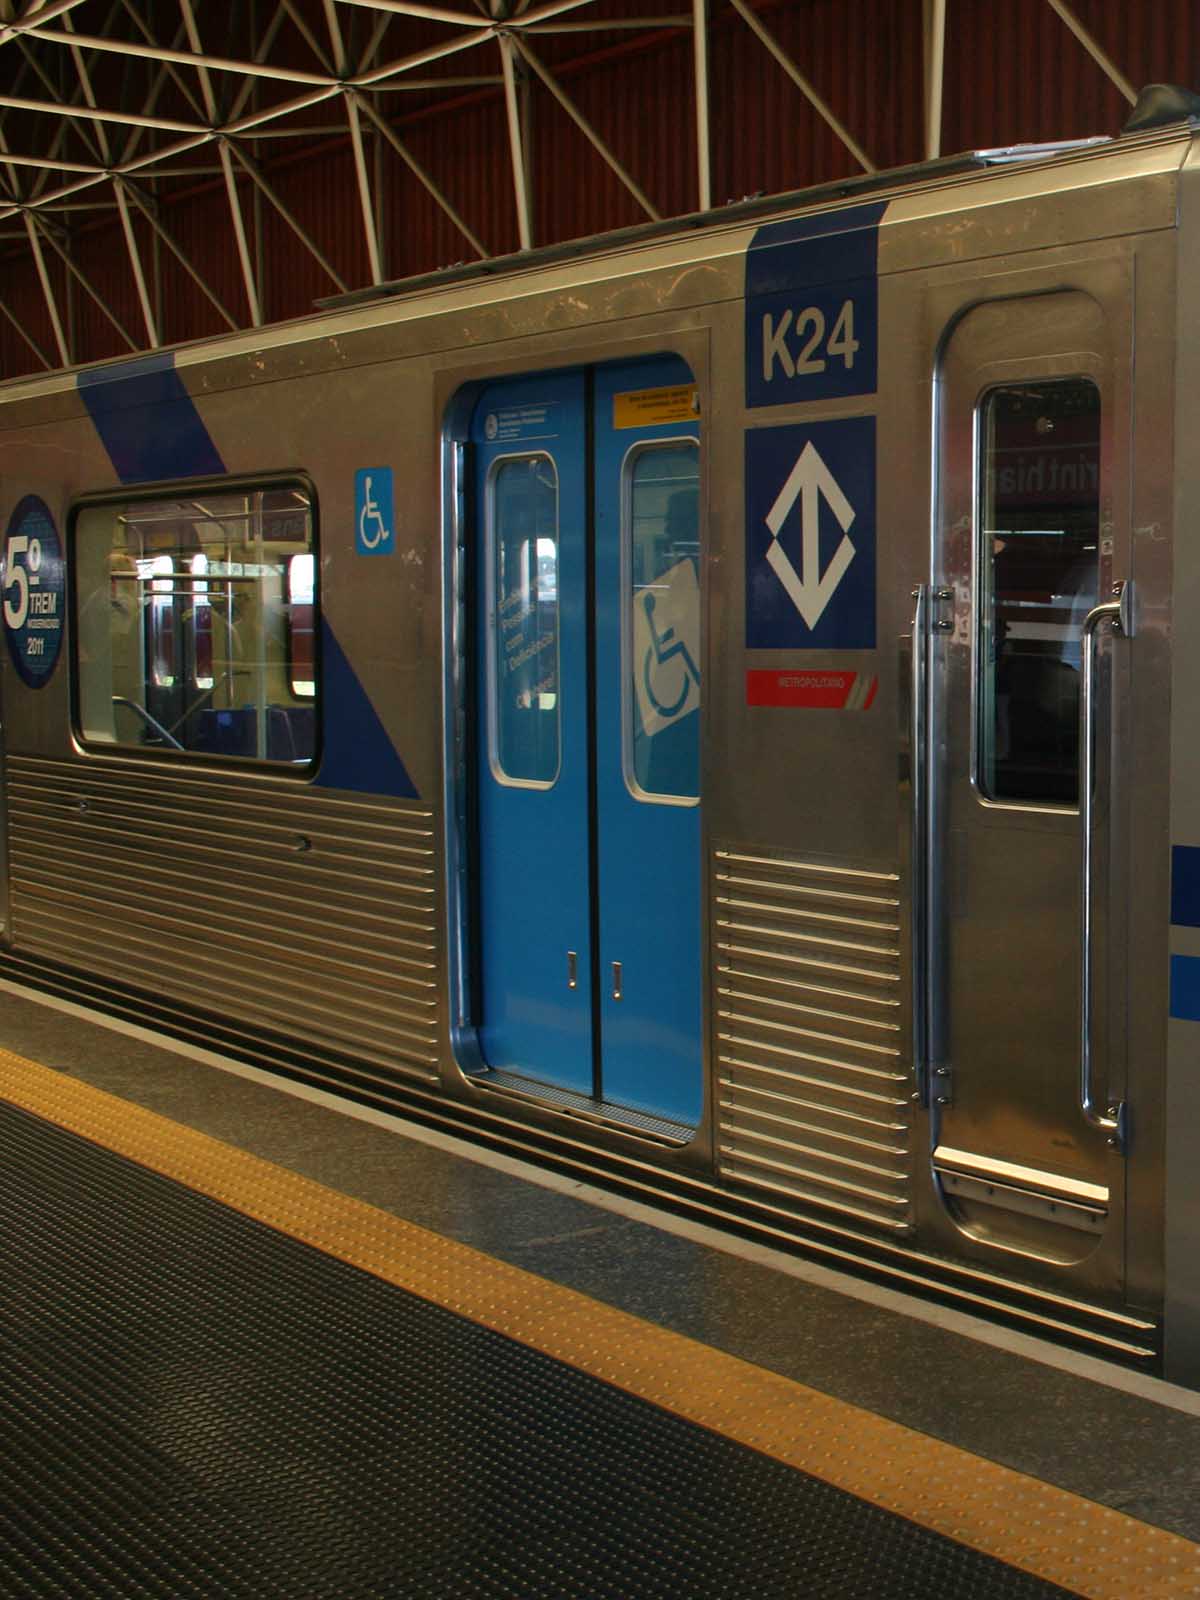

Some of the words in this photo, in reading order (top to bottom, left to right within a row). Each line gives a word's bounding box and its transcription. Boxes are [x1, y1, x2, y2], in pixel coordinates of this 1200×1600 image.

[762, 299, 860, 382] K24
[29, 592, 57, 614] TREM
[26, 637, 45, 656] 2011
